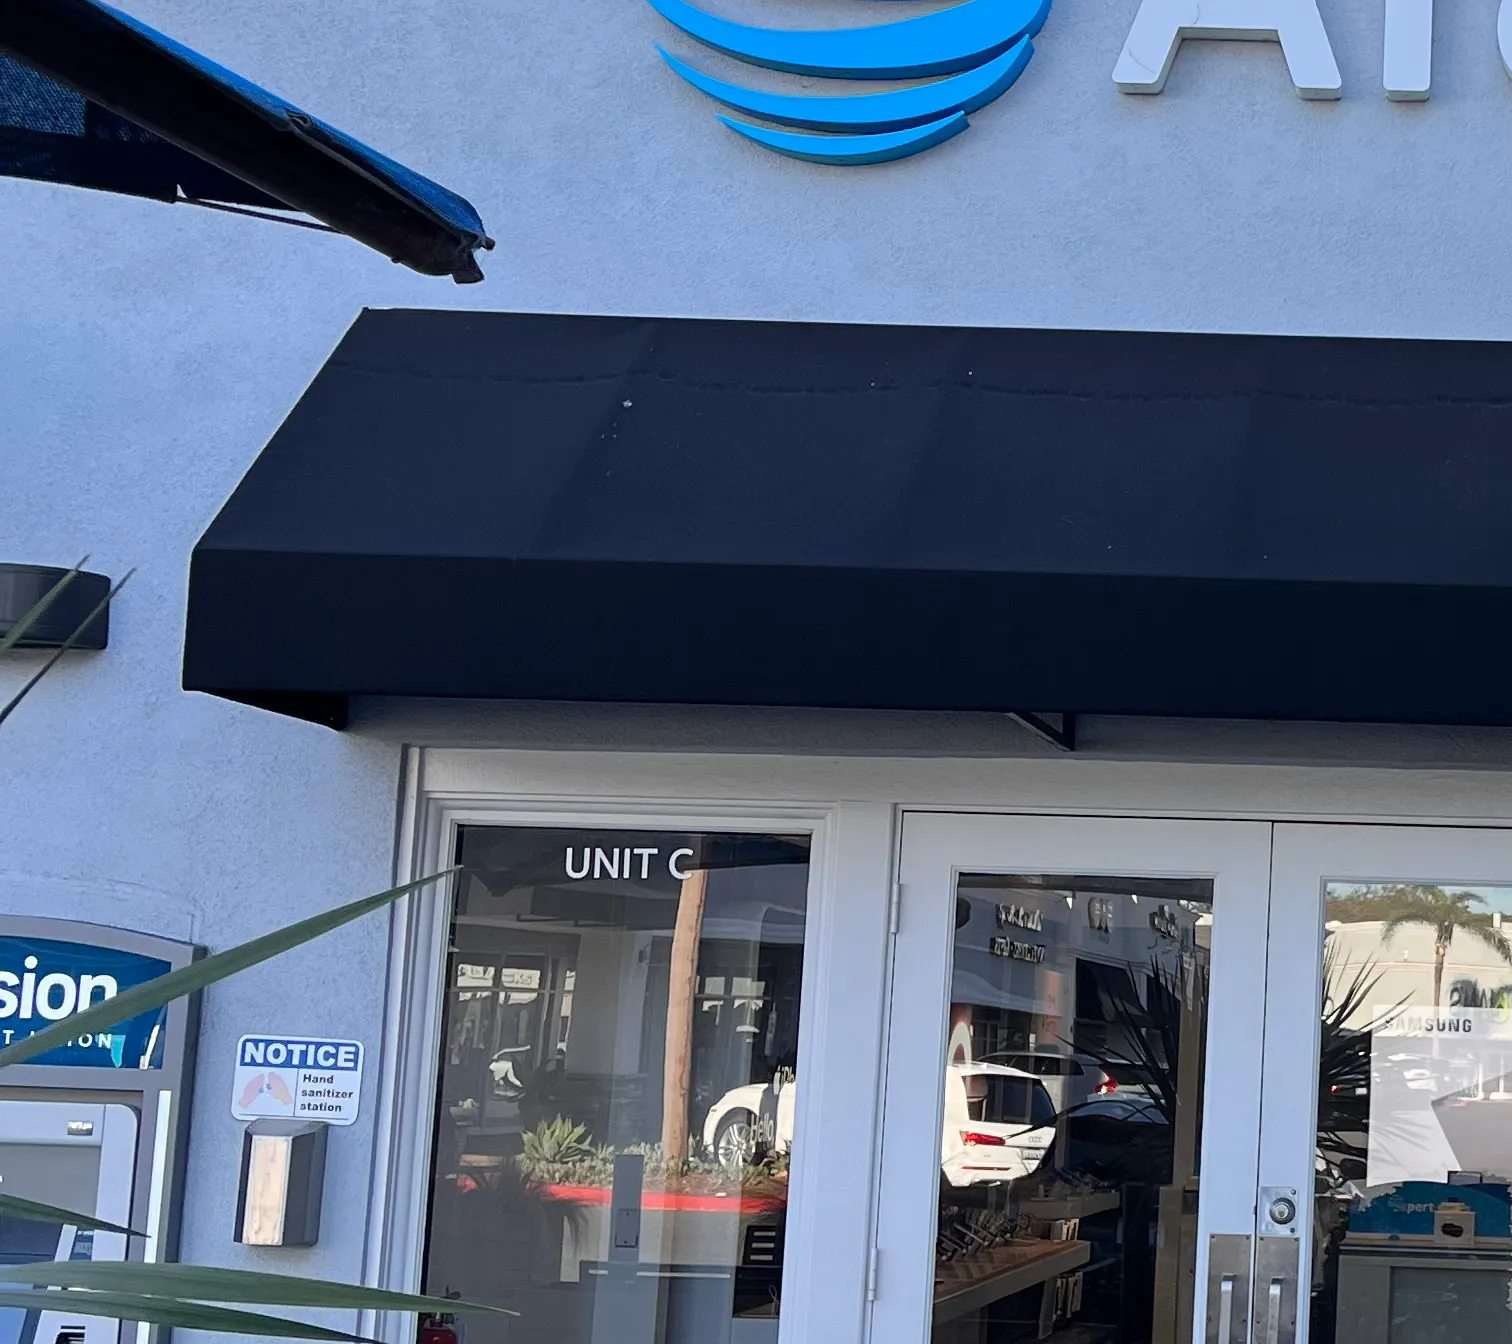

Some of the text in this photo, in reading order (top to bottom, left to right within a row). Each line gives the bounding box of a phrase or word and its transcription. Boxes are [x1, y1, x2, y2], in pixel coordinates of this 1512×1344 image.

[565, 847, 694, 880] UNIT C
[243, 1041, 356, 1068] NOTICE
[303, 1074, 334, 1084] Hand
[301, 1088, 354, 1099] sanitizer
[300, 1102, 342, 1113] station
